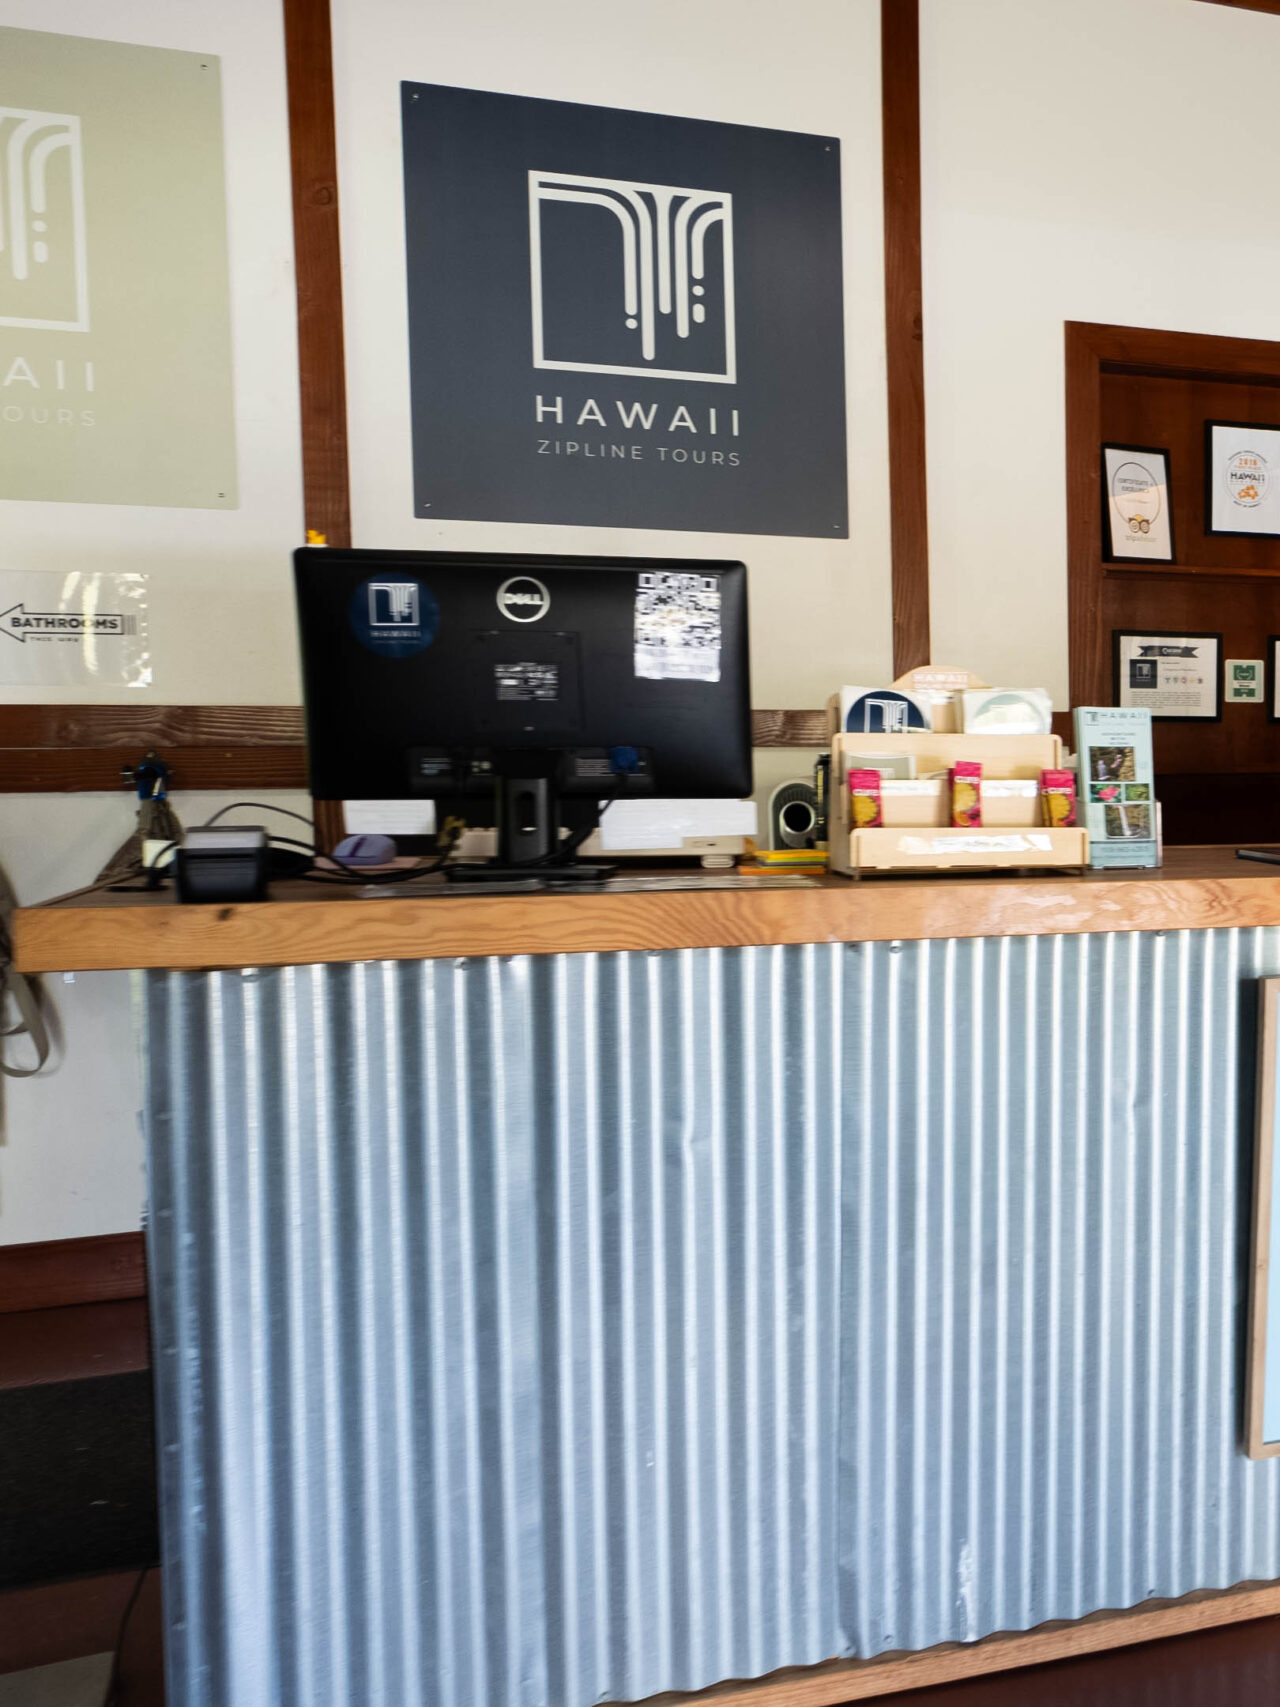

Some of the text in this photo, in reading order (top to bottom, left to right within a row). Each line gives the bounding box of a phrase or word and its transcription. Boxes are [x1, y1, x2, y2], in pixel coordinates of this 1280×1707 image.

[535, 394, 740, 437] HAWAII
[537, 439, 741, 466] ZIPLINE TOURS
[503, 592, 545, 605] DELL
[11, 616, 119, 630] BATHROOMS
